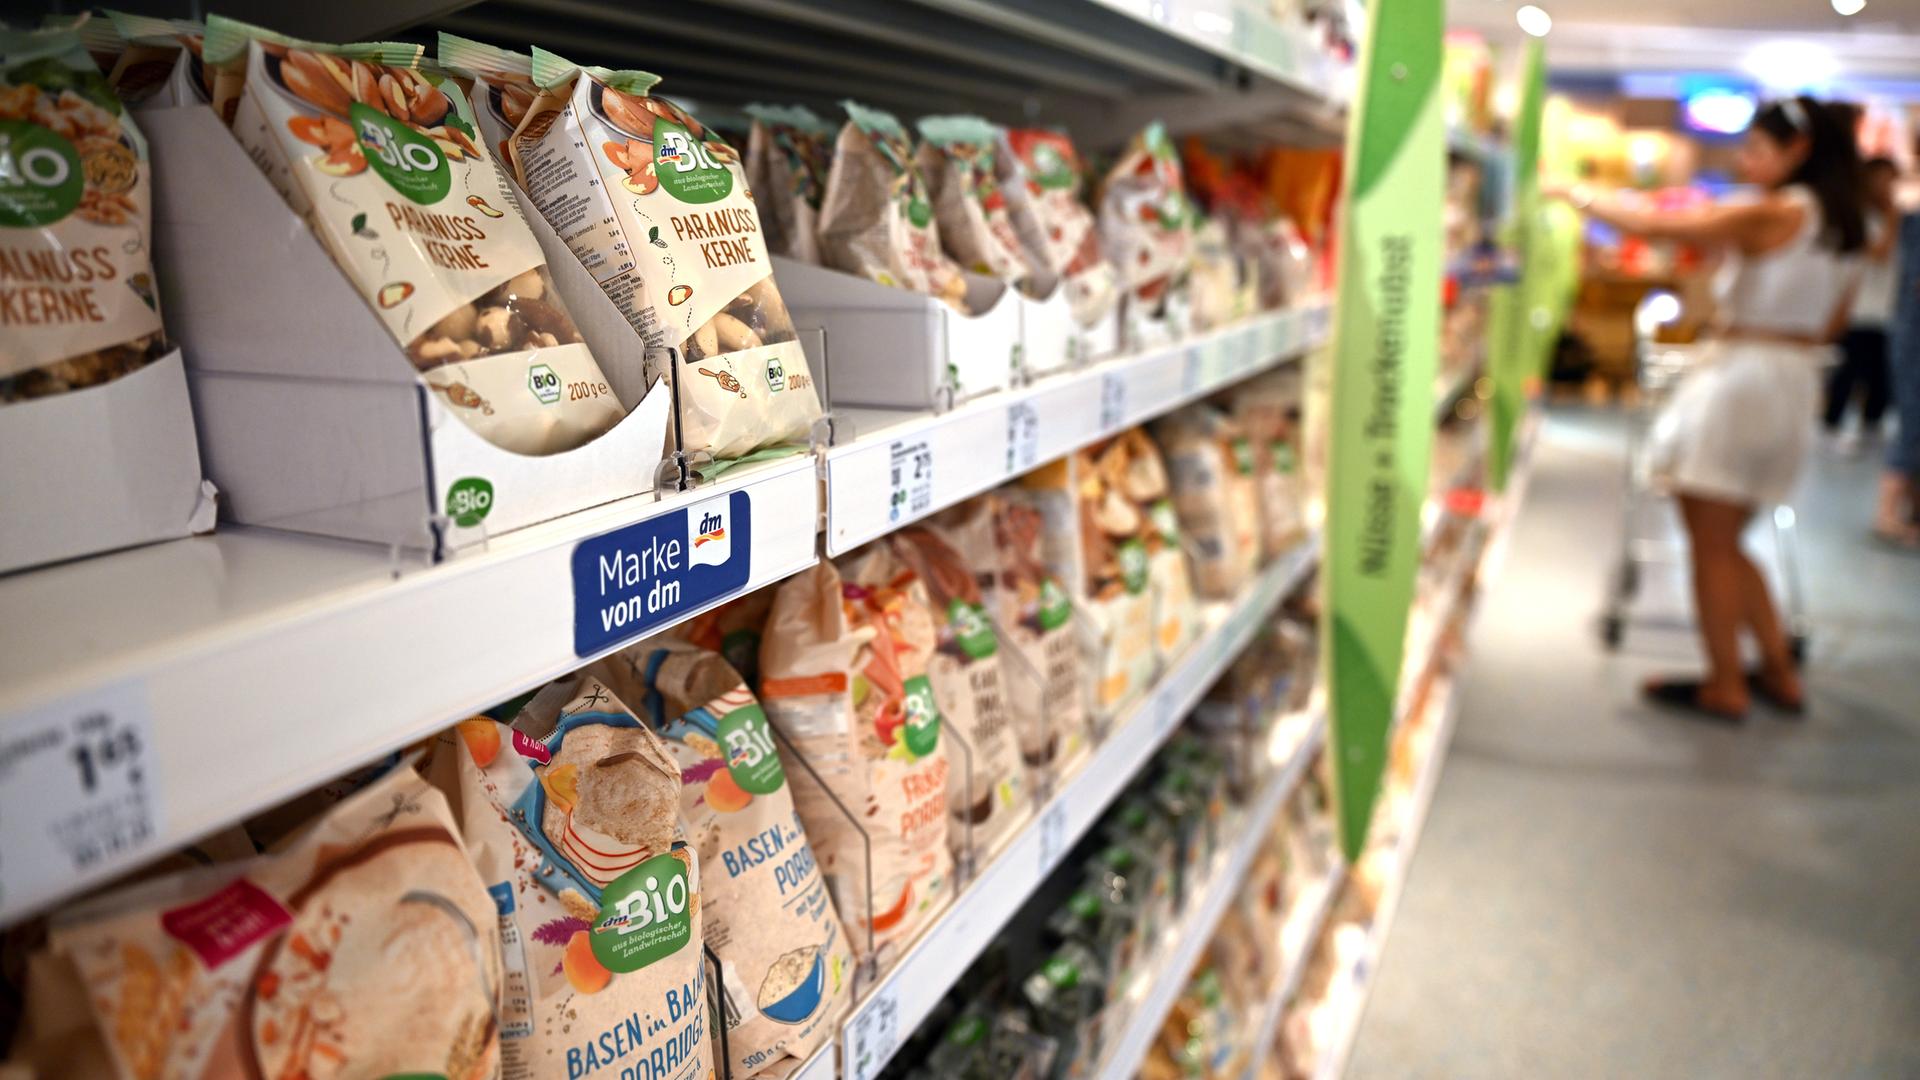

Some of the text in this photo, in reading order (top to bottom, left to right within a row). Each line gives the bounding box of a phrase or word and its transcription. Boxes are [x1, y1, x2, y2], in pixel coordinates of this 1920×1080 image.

[386, 202, 486, 241] PARANUSS
[671, 208, 757, 242] PARANUSS
[423, 239, 489, 270] KERNE
[700, 237, 756, 269] KERNE
[456, 486, 491, 514] Bio
[699, 512, 722, 535] dm
[600, 536, 681, 596] Marke
[601, 579, 681, 633] von dm
[722, 824, 785, 879] BASEN
[603, 914, 628, 928] dm
[615, 874, 687, 935] Bio
[611, 920, 682, 953] aus biologischer
[622, 925, 688, 958] Landwirtschaft
[567, 1012, 643, 1080] BASEN
[646, 1014, 667, 1038] in
[742, 1050, 767, 1070] 500
